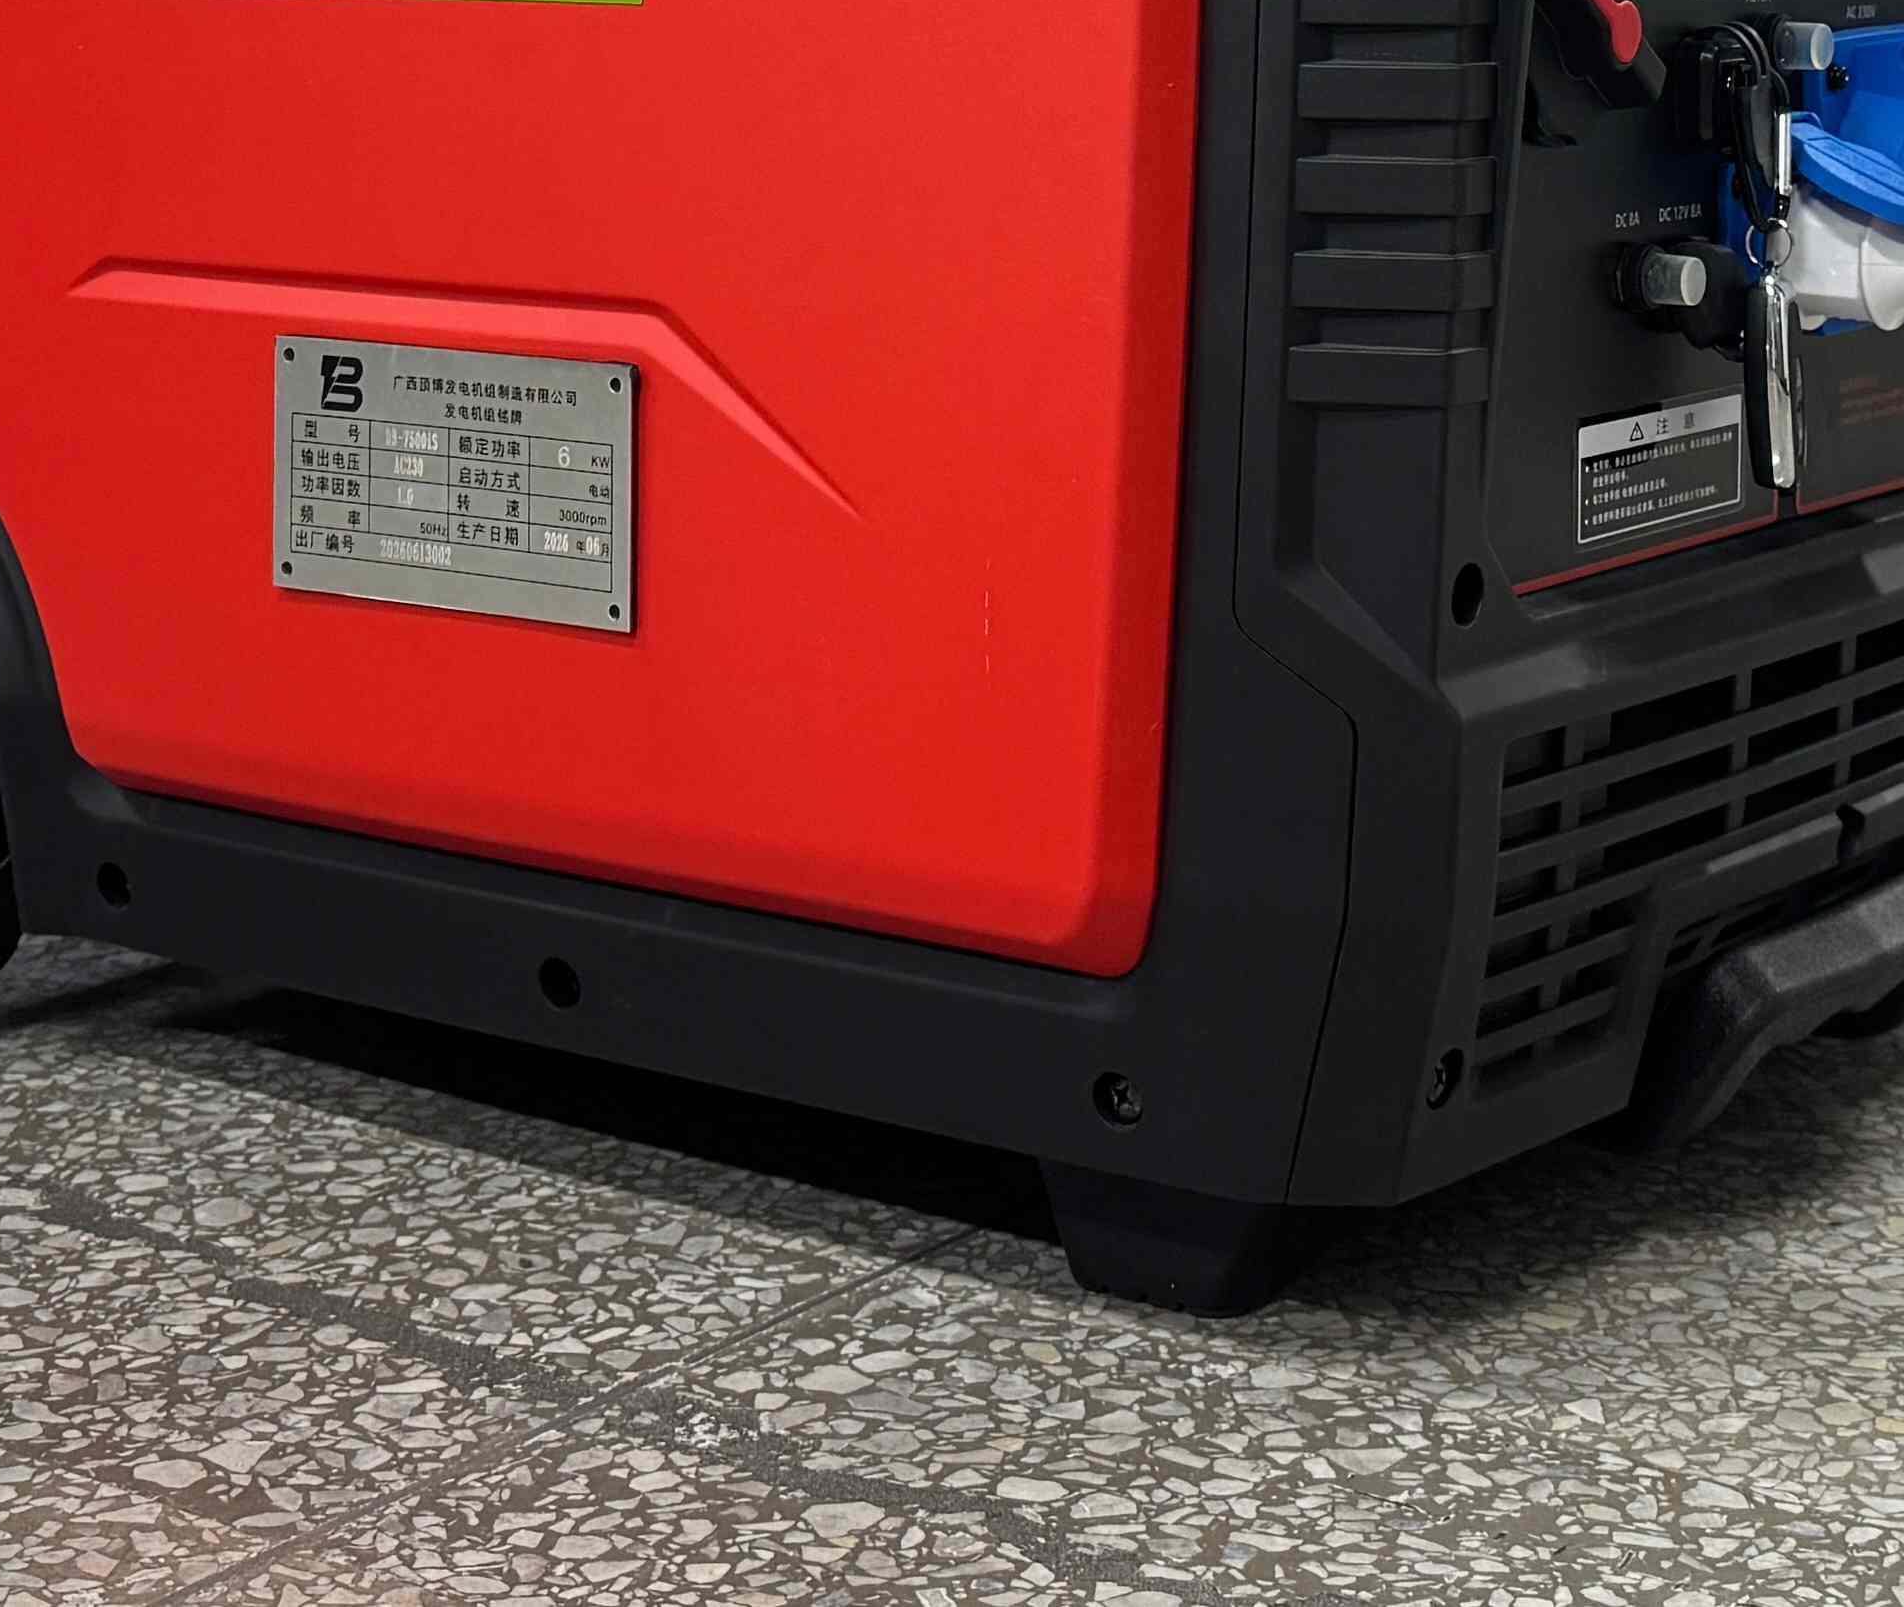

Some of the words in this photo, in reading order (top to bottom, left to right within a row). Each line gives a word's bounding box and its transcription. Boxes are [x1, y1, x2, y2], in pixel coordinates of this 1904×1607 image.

[393, 375, 578, 407] 广西顶博发电机组制造有限公司
[301, 447, 361, 471] 输出电压
[458, 435, 521, 459] 额定功率
[557, 445, 571, 467] 6
[591, 455, 610, 469] KW
[301, 474, 361, 499] 功率因数
[459, 466, 521, 491] 启动方式
[295, 529, 355, 554] 出厂编号
[419, 521, 447, 538] 50Hz
[456, 521, 520, 546] 生产日期
